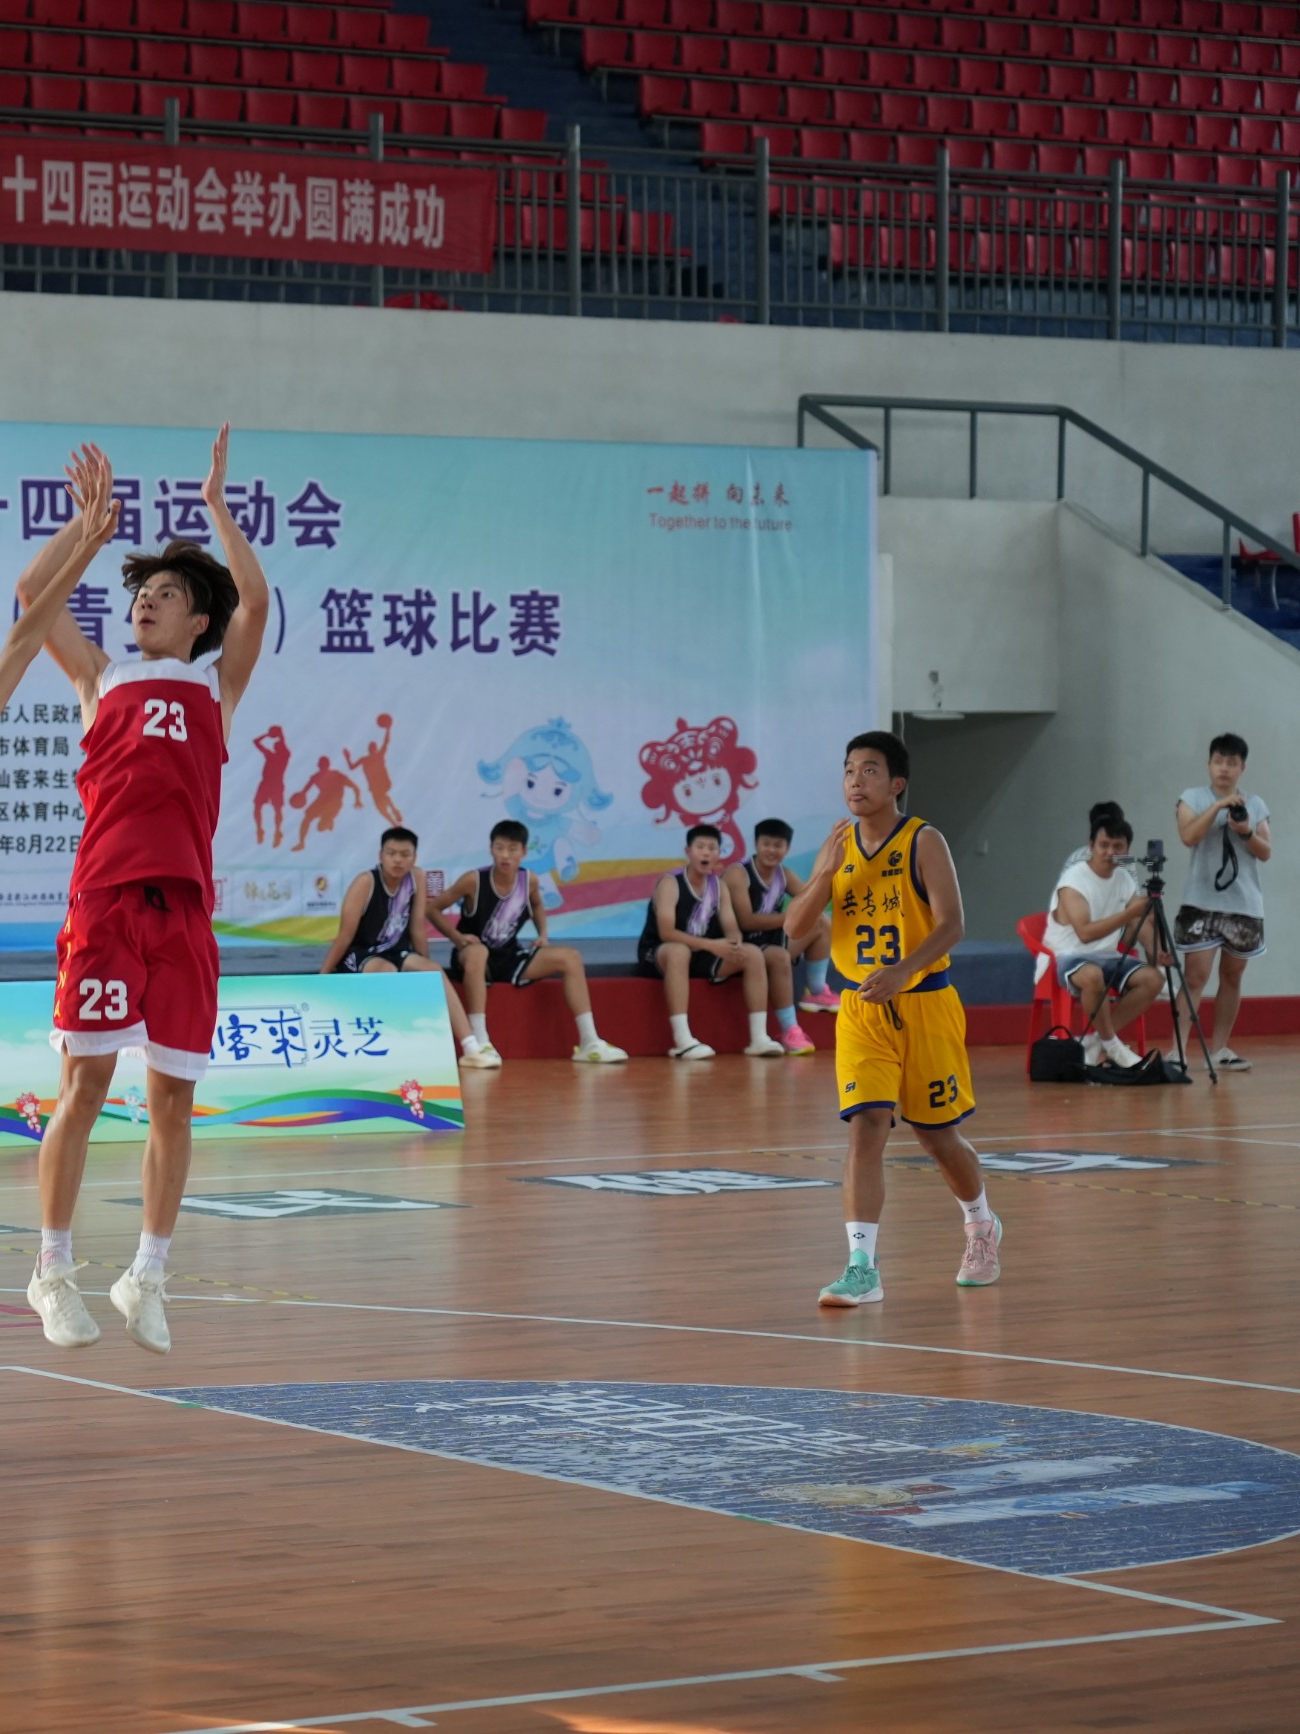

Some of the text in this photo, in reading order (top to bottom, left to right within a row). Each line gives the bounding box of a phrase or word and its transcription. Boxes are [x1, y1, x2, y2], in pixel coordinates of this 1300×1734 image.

[650, 512, 710, 532] Together
[714, 516, 727, 529] to
[730, 516, 750, 530] the
[142, 698, 188, 741] 23
[855, 924, 902, 966] 23
[78, 978, 128, 1020] 23
[928, 1074, 959, 1109] 23
